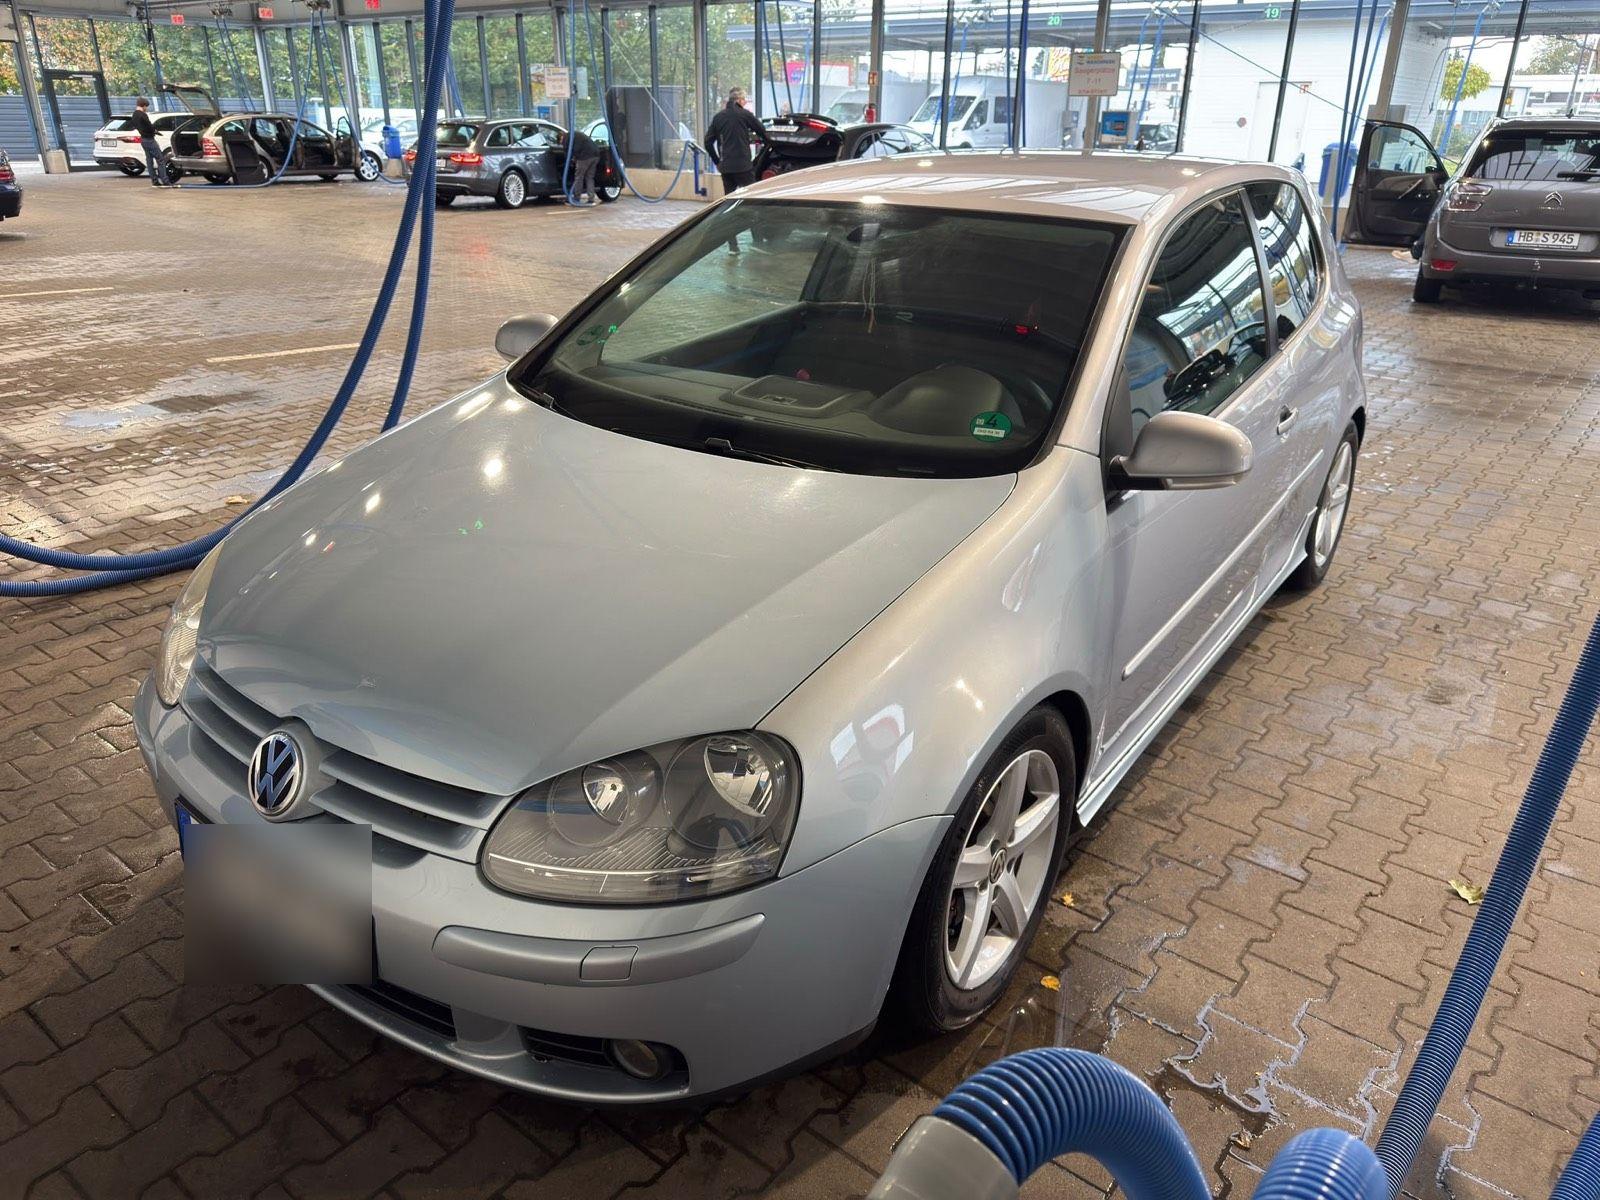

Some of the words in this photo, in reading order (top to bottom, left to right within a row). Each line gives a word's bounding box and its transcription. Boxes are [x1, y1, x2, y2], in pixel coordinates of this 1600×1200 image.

[1265, 8, 1279, 18] 19
[1048, 16, 1060, 25] 20
[1518, 231, 1534, 243] HB
[1541, 232, 1550, 243] S
[1552, 233, 1575, 244] 945
[986, 414, 997, 428] 4
